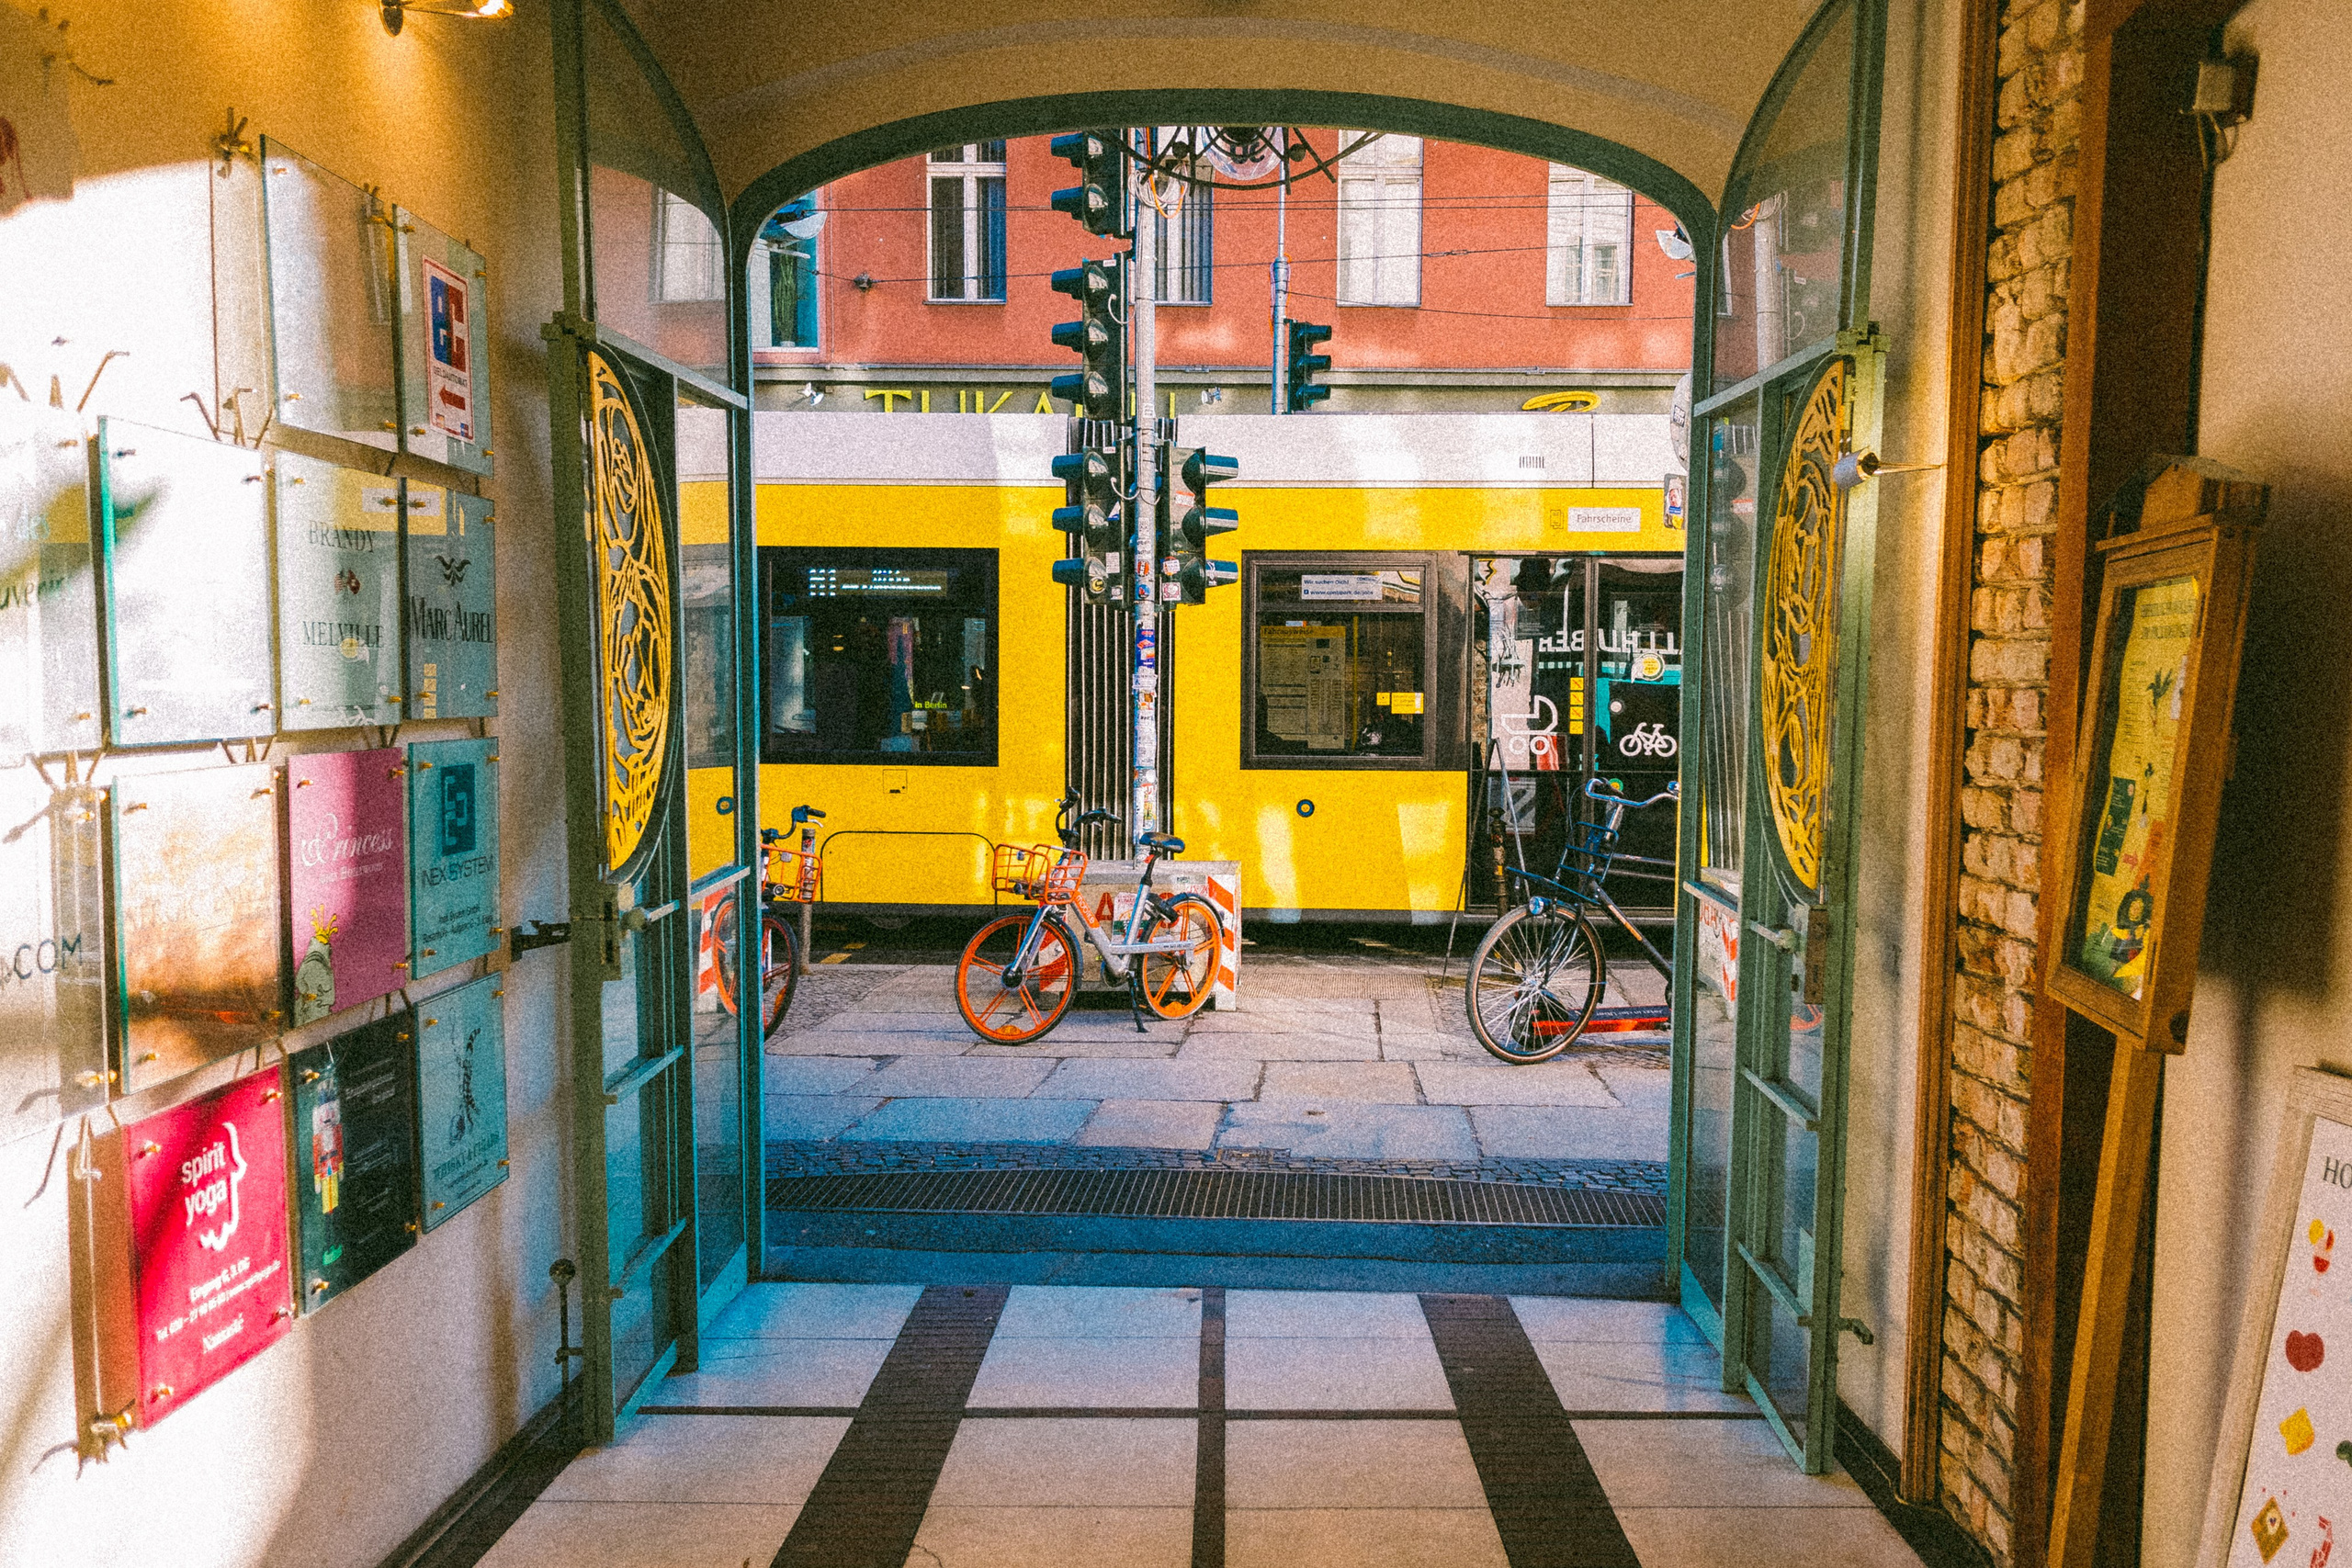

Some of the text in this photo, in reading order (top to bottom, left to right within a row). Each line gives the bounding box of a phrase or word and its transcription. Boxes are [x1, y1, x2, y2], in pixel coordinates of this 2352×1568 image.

[309, 520, 376, 553] BRANDY
[1577, 514, 1632, 524] Fahrscheine
[302, 621, 385, 649] MELVILLE
[411, 596, 494, 643] MARC AUREL
[924, 701, 947, 709] Berlin
[301, 813, 393, 867] Princess
[181, 1141, 227, 1188] spirit
[185, 1179, 227, 1227] yoga
